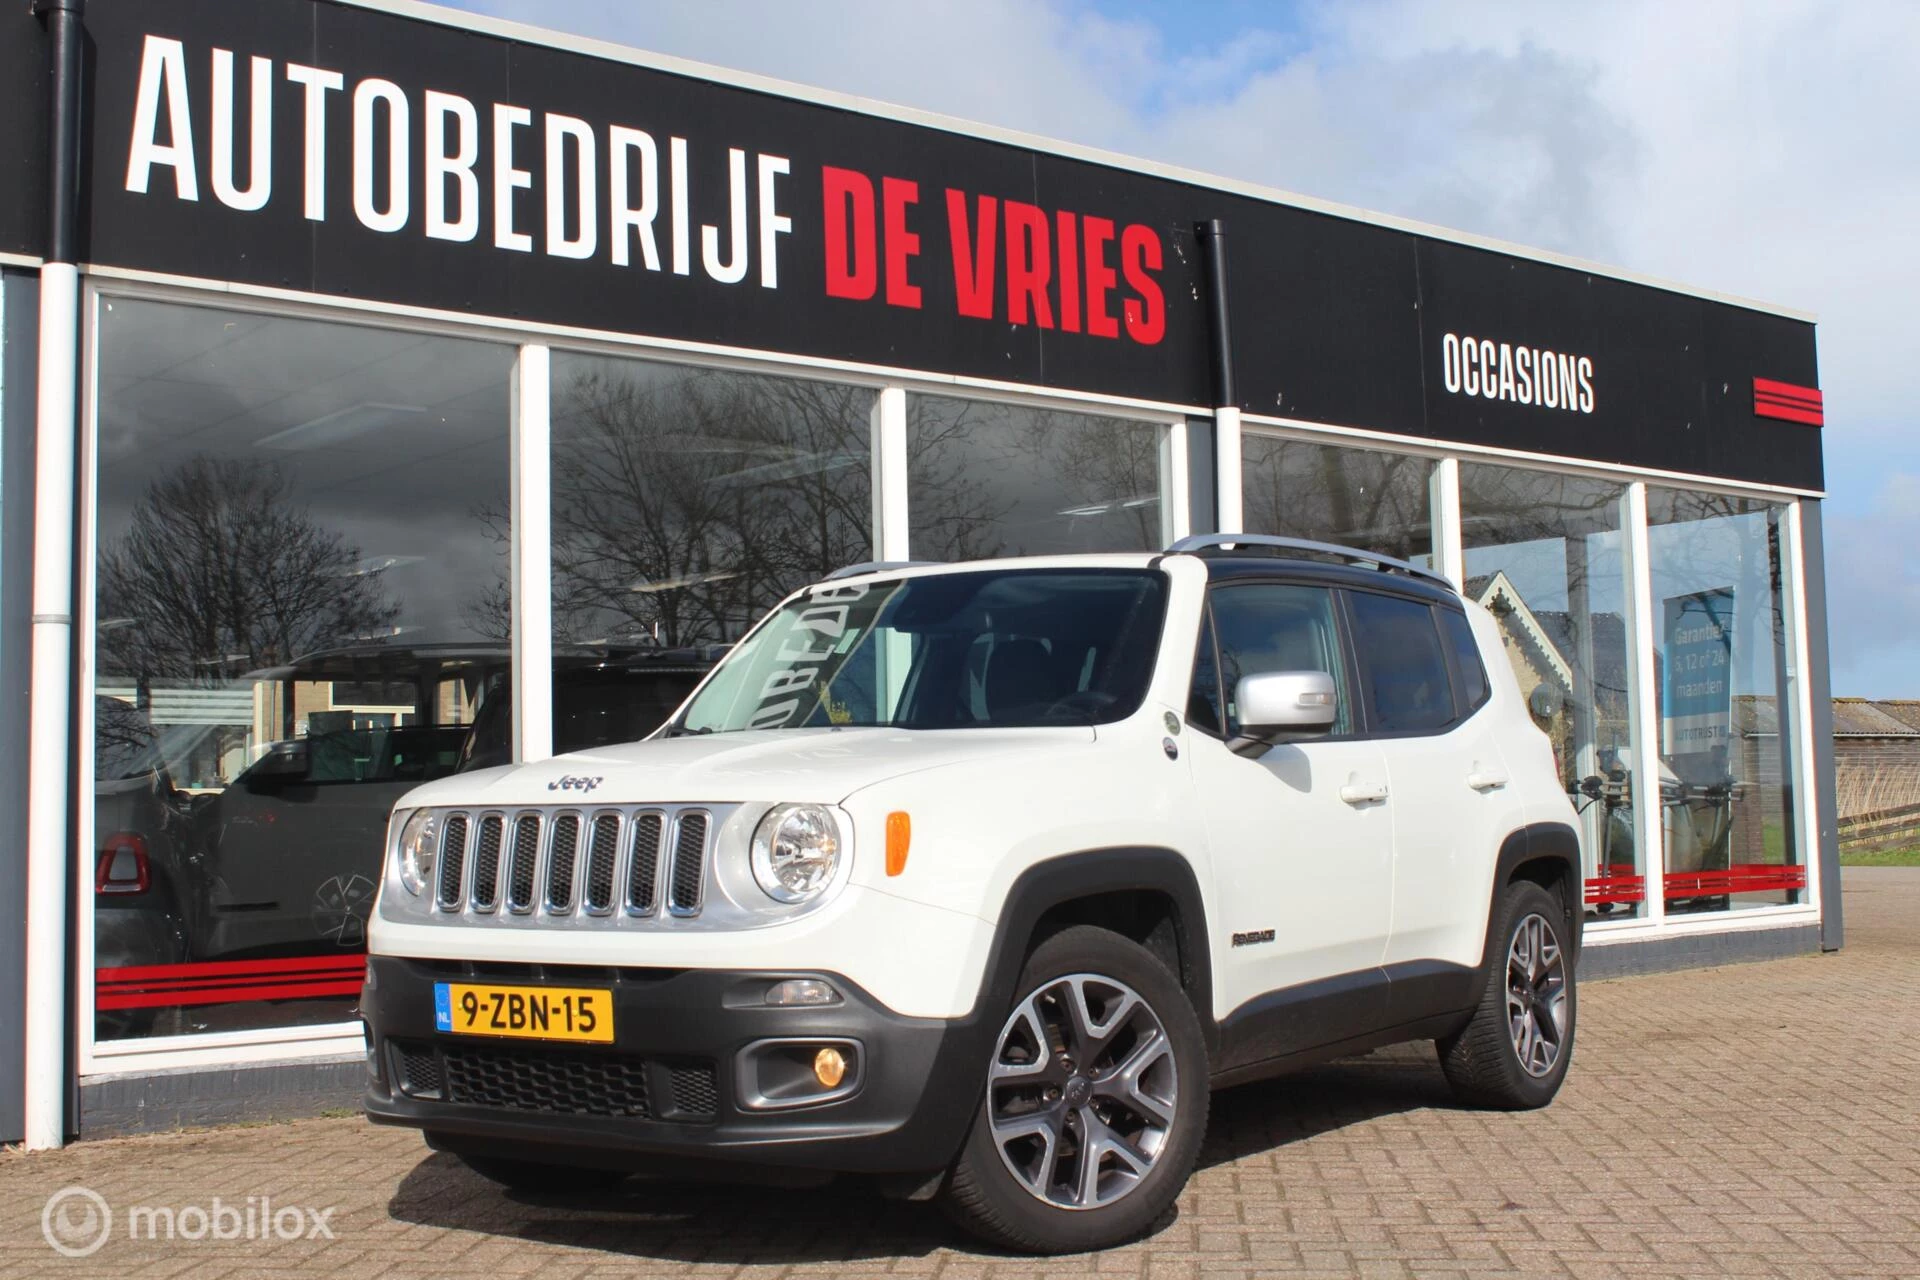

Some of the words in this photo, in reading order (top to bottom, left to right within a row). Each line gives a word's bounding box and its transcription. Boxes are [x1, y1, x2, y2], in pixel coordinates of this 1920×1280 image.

[125, 34, 792, 289] AUTOBEDRIJF
[821, 165, 923, 310] DE
[945, 187, 1166, 346] VRIES
[1442, 332, 1595, 414] OCCASIONS
[547, 774, 604, 793] Jeep
[438, 1011, 451, 1023] NL
[461, 991, 597, 1033] 9-ZBN-15
